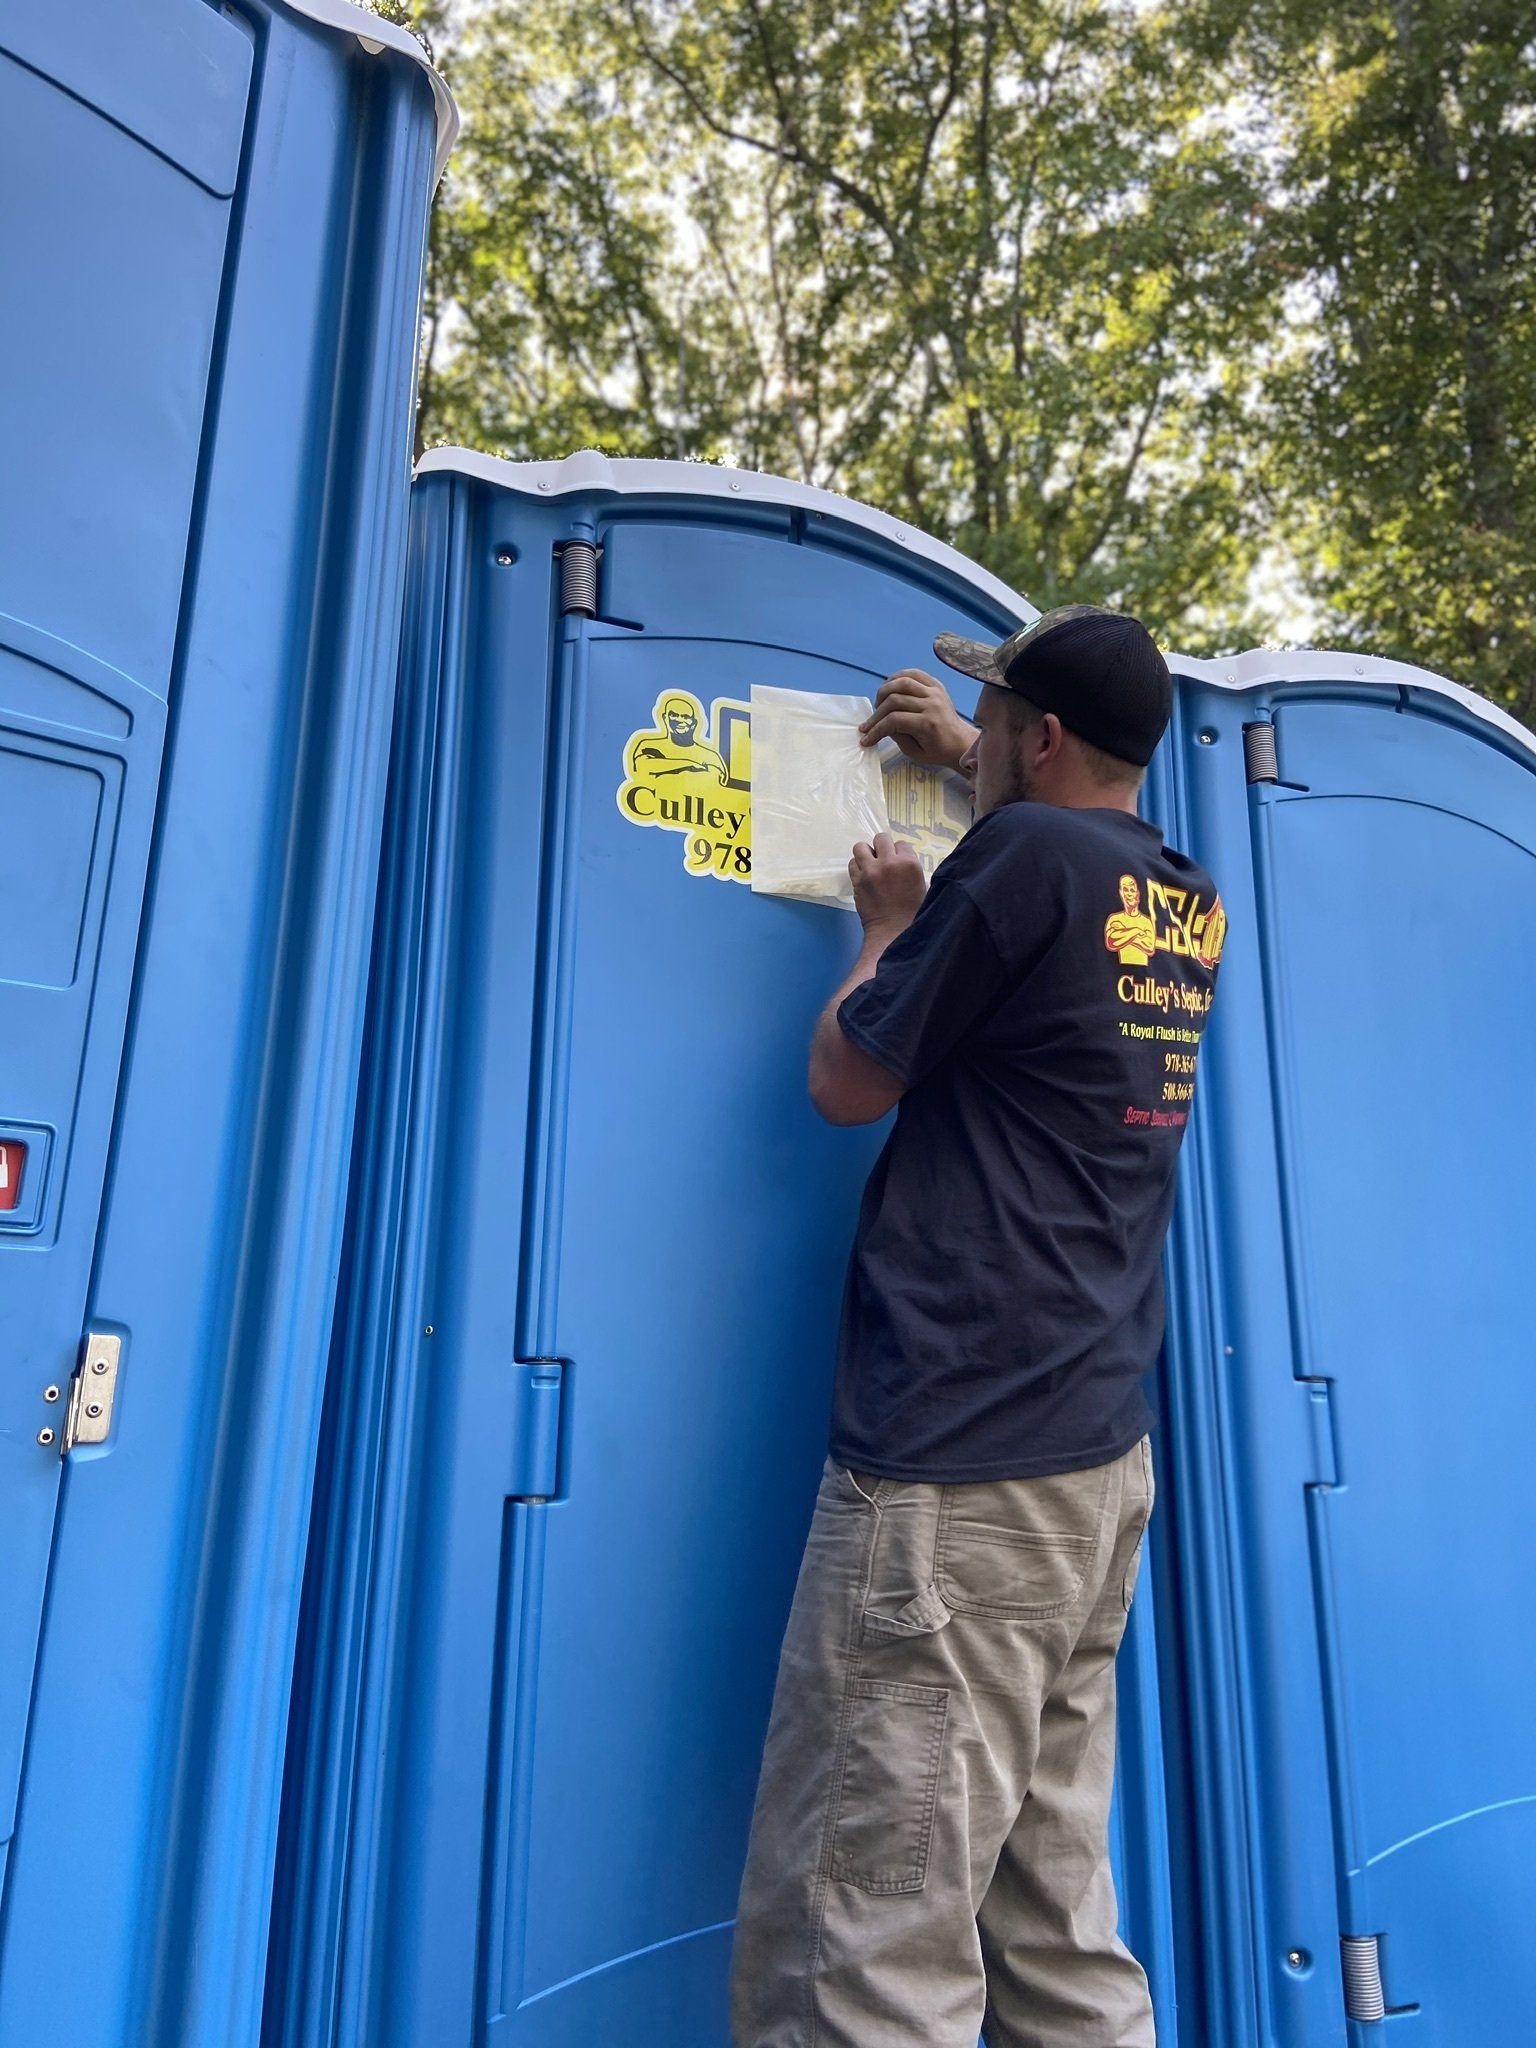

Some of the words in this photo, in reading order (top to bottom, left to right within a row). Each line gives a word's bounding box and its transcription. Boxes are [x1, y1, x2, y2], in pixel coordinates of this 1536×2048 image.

[693, 838, 752, 873] 978
[1117, 975, 1180, 1013] Culley's
[1130, 1023, 1155, 1040] Royal
[1156, 1025, 1176, 1041] Flush
[1177, 1027, 1182, 1042] is
